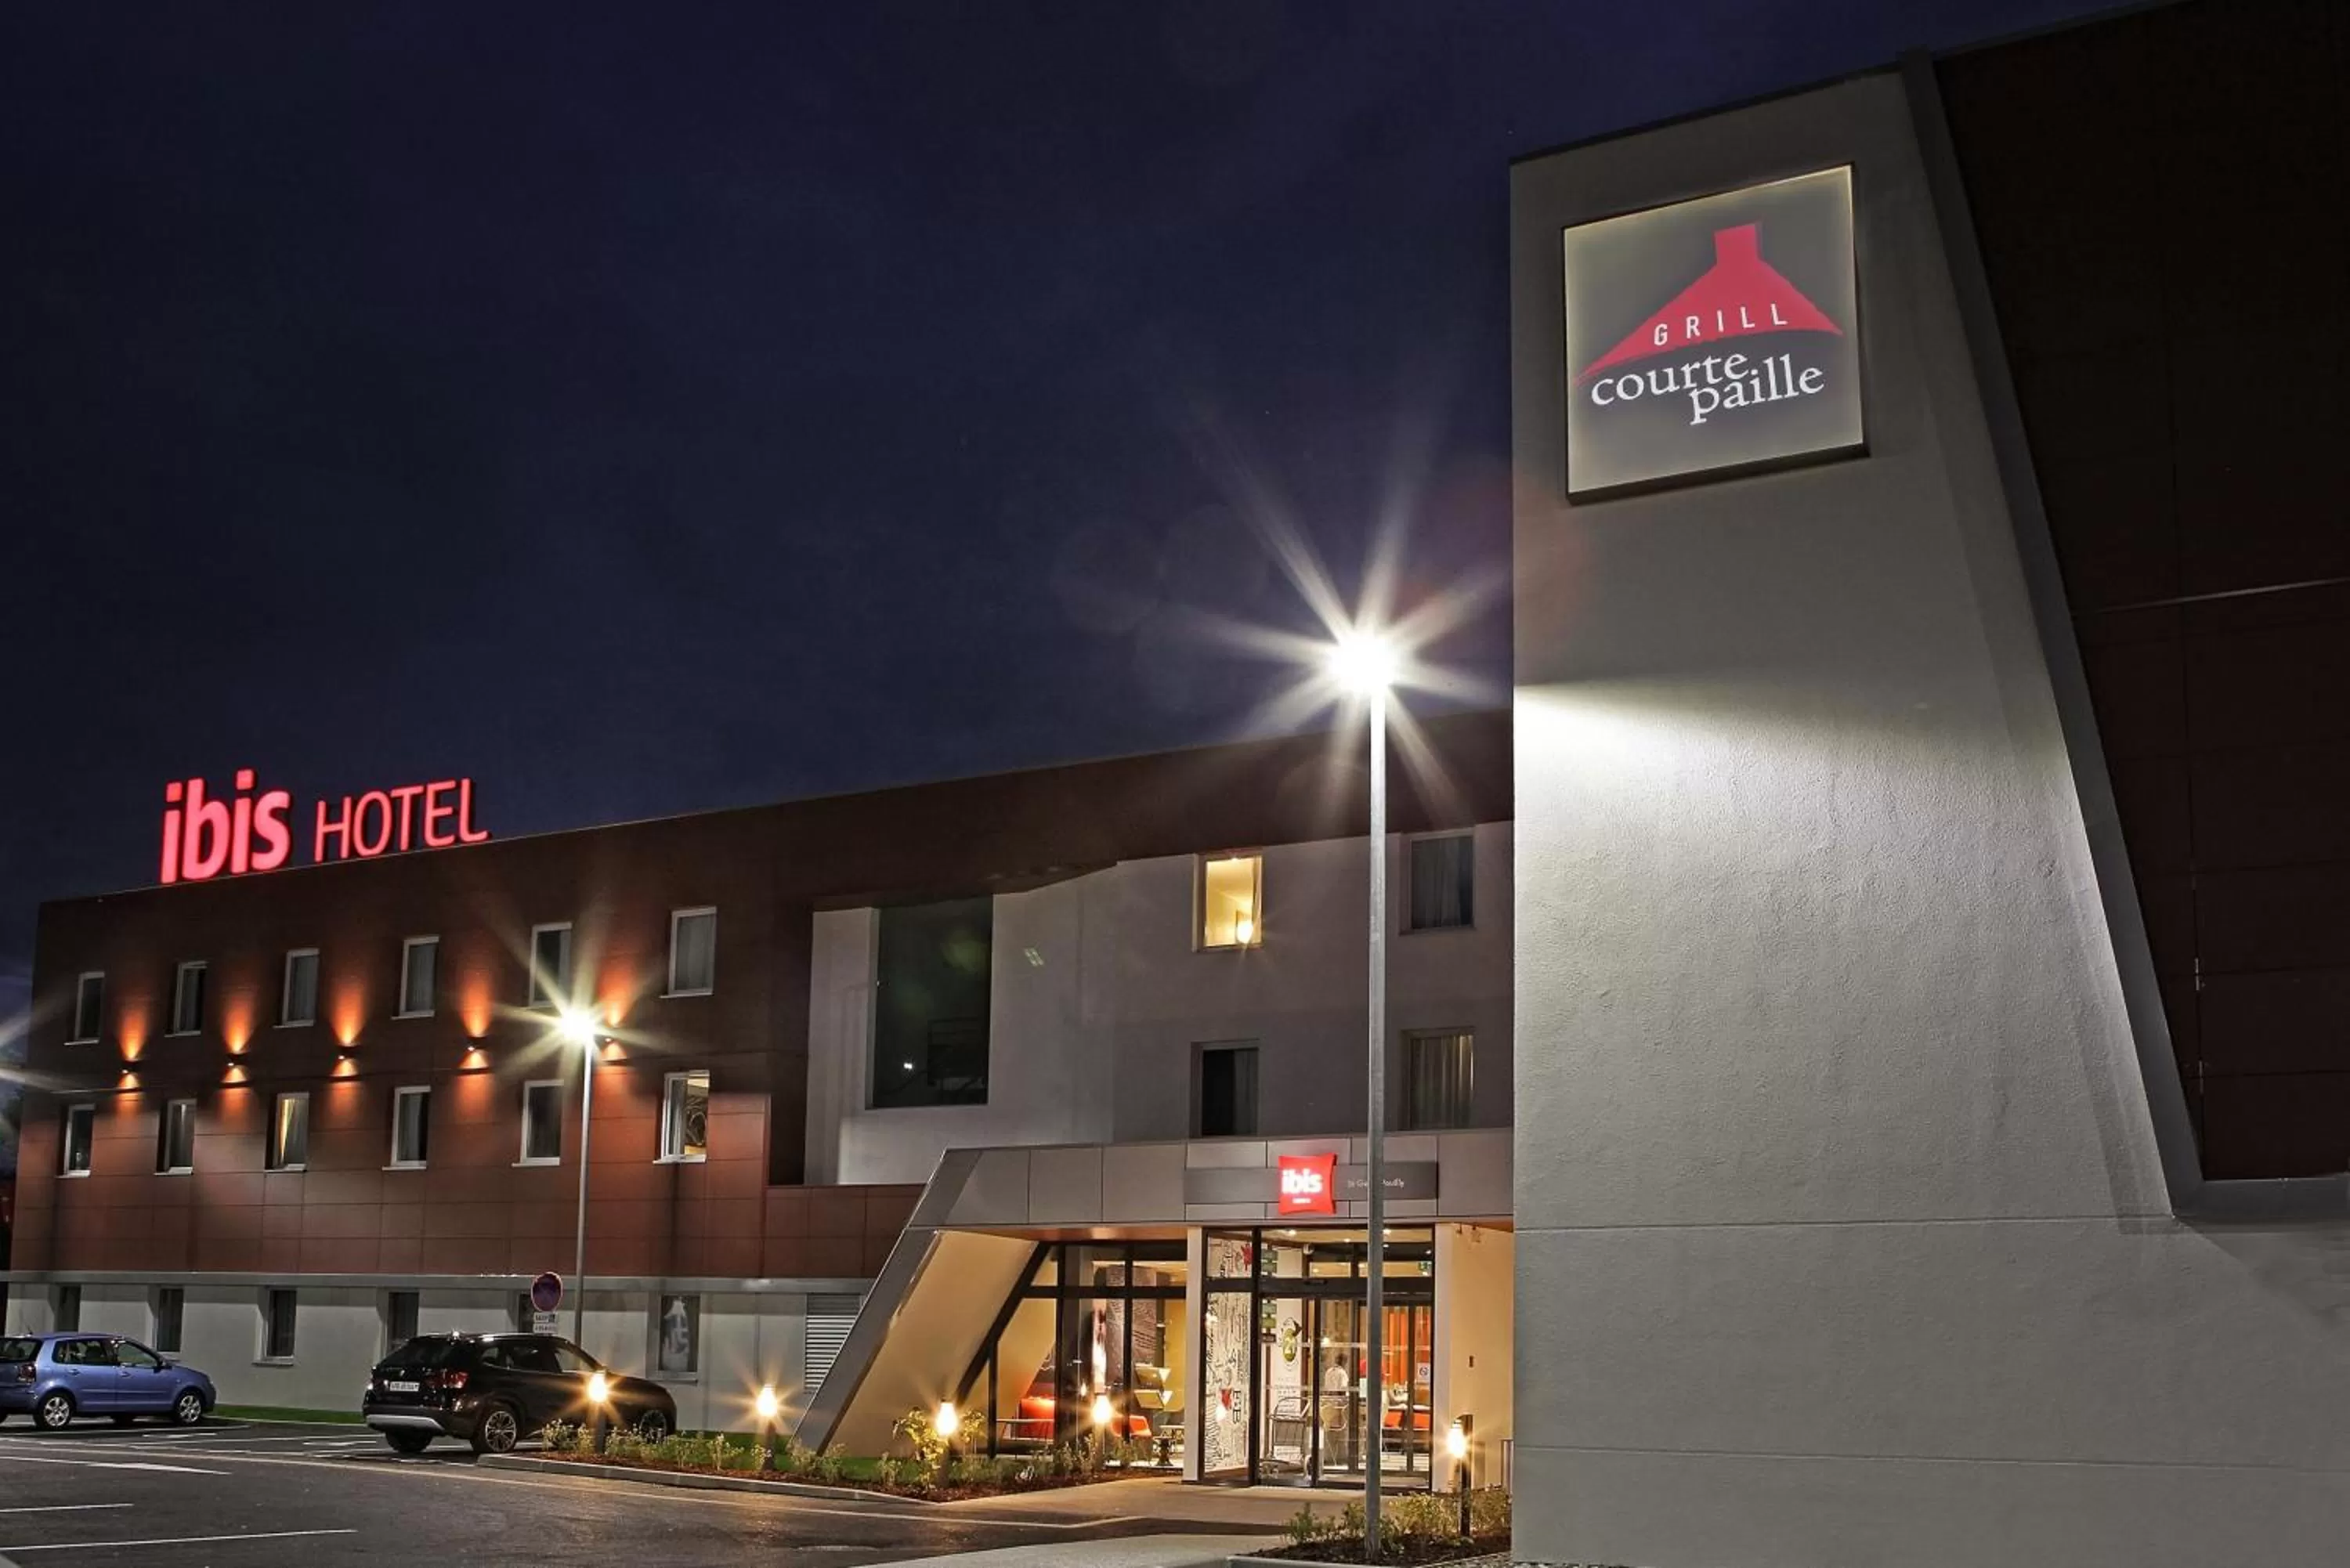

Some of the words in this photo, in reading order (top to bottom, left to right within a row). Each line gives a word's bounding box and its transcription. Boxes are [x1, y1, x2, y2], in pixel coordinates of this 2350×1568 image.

[1654, 303, 1788, 346] GRILL
[1590, 352, 1750, 406] courte
[1688, 353, 1825, 426] paille
[161, 769, 291, 883] ibis
[315, 779, 488, 863] HOTEL
[1281, 1168, 1323, 1194] ibis
